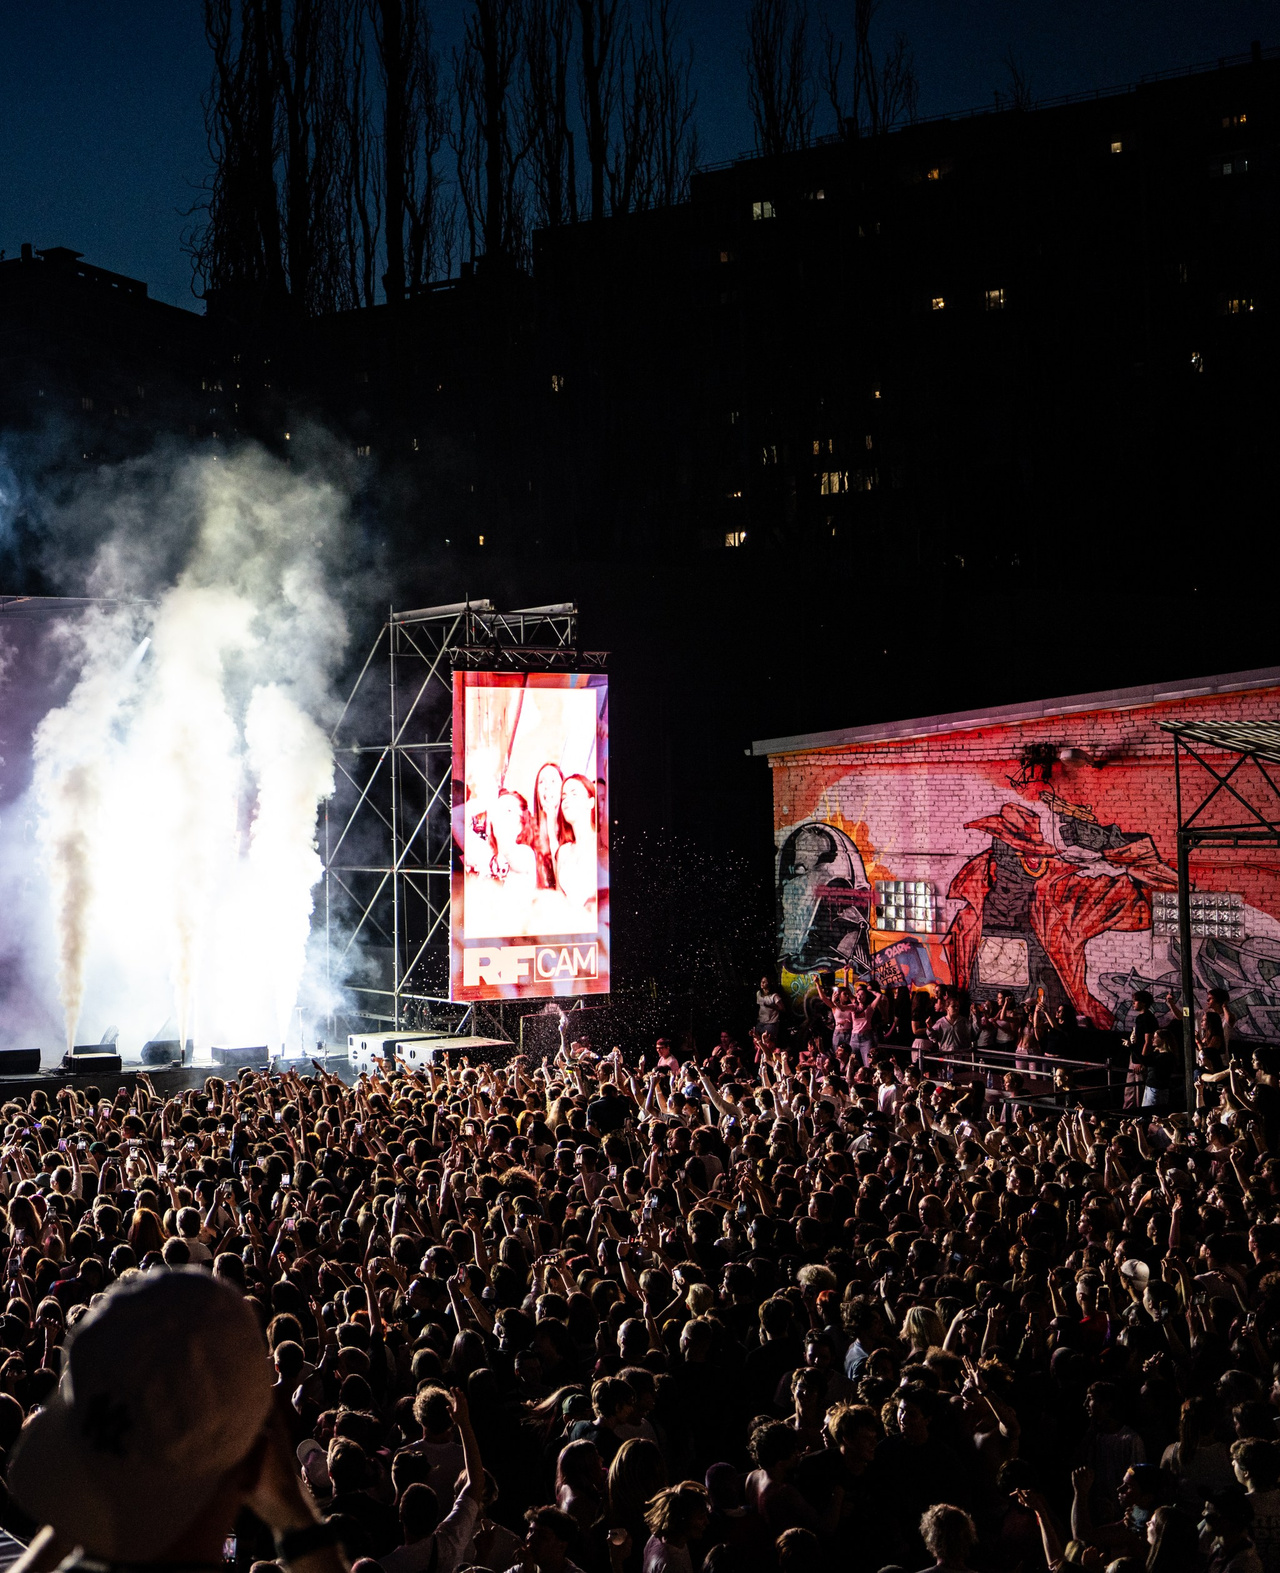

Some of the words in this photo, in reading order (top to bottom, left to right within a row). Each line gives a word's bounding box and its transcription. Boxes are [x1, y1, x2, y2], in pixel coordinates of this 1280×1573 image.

[884, 942, 911, 958] DARK
[463, 946, 536, 987] RF
[537, 946, 595, 978] CAM
